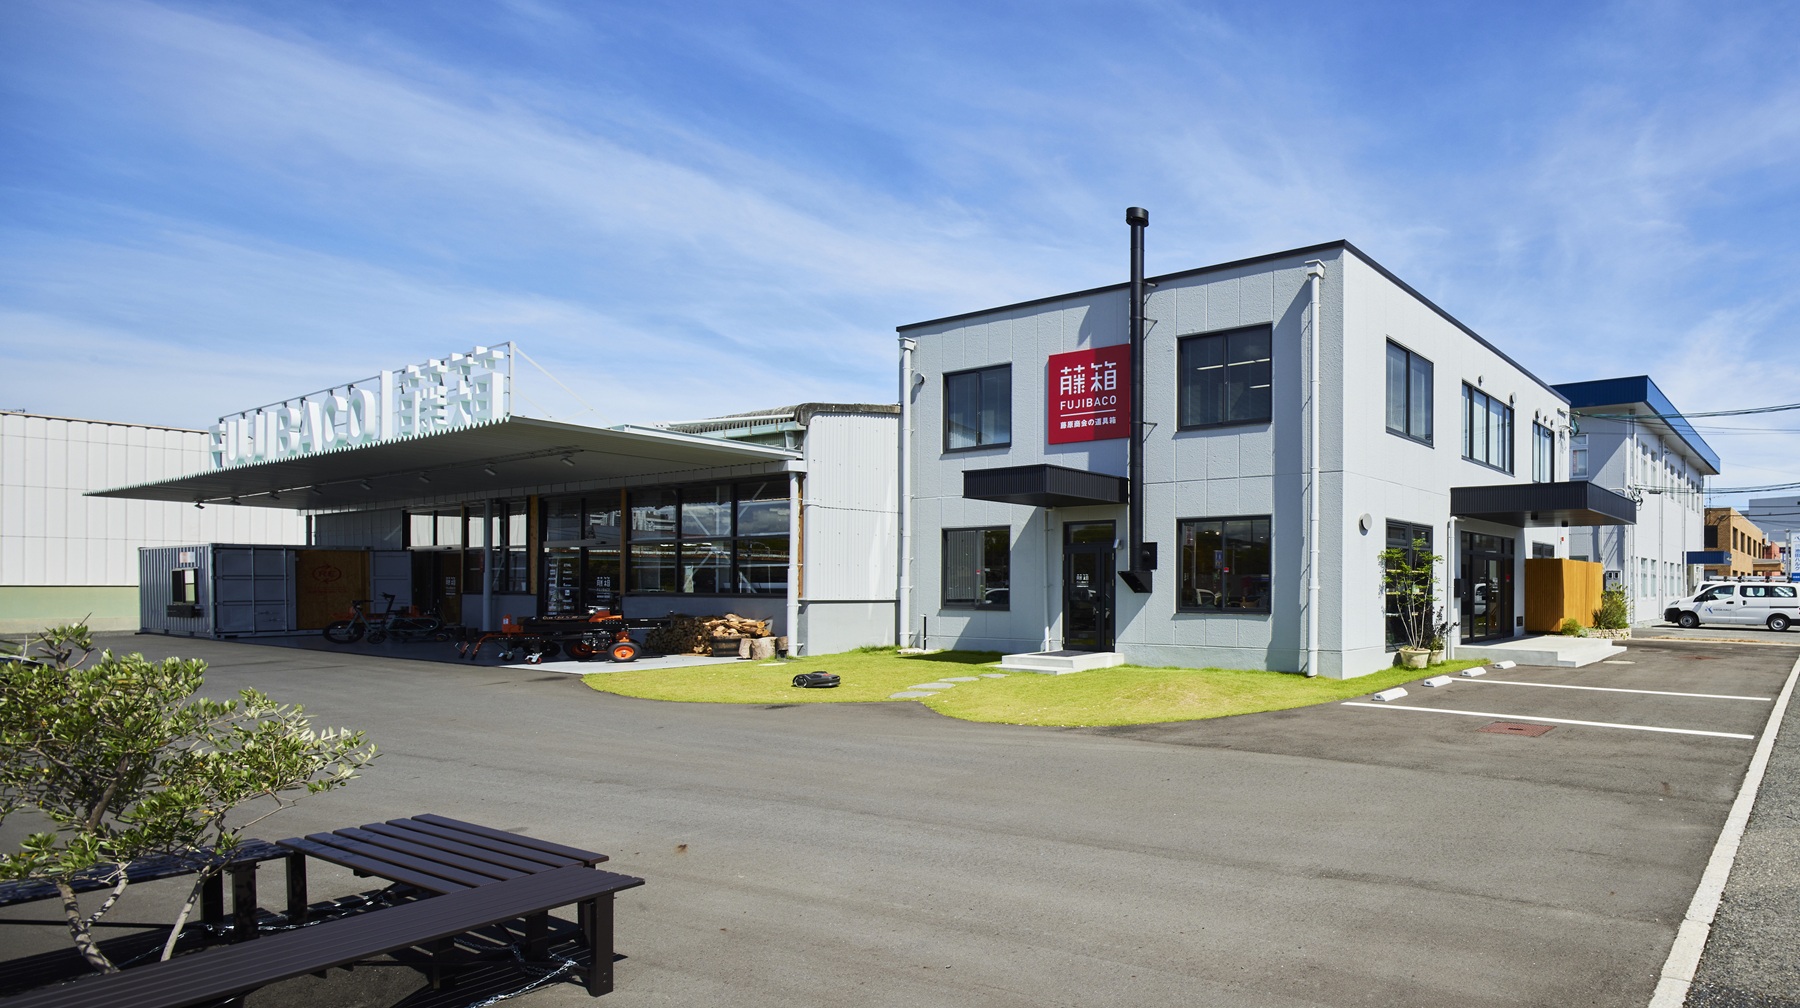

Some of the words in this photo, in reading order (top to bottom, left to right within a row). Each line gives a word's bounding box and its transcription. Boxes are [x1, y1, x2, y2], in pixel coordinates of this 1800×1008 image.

[1060, 360, 1117, 396] 藤箱
[1060, 395, 1117, 411] FUJIBACO
[208, 388, 376, 468] FUJIBACO
